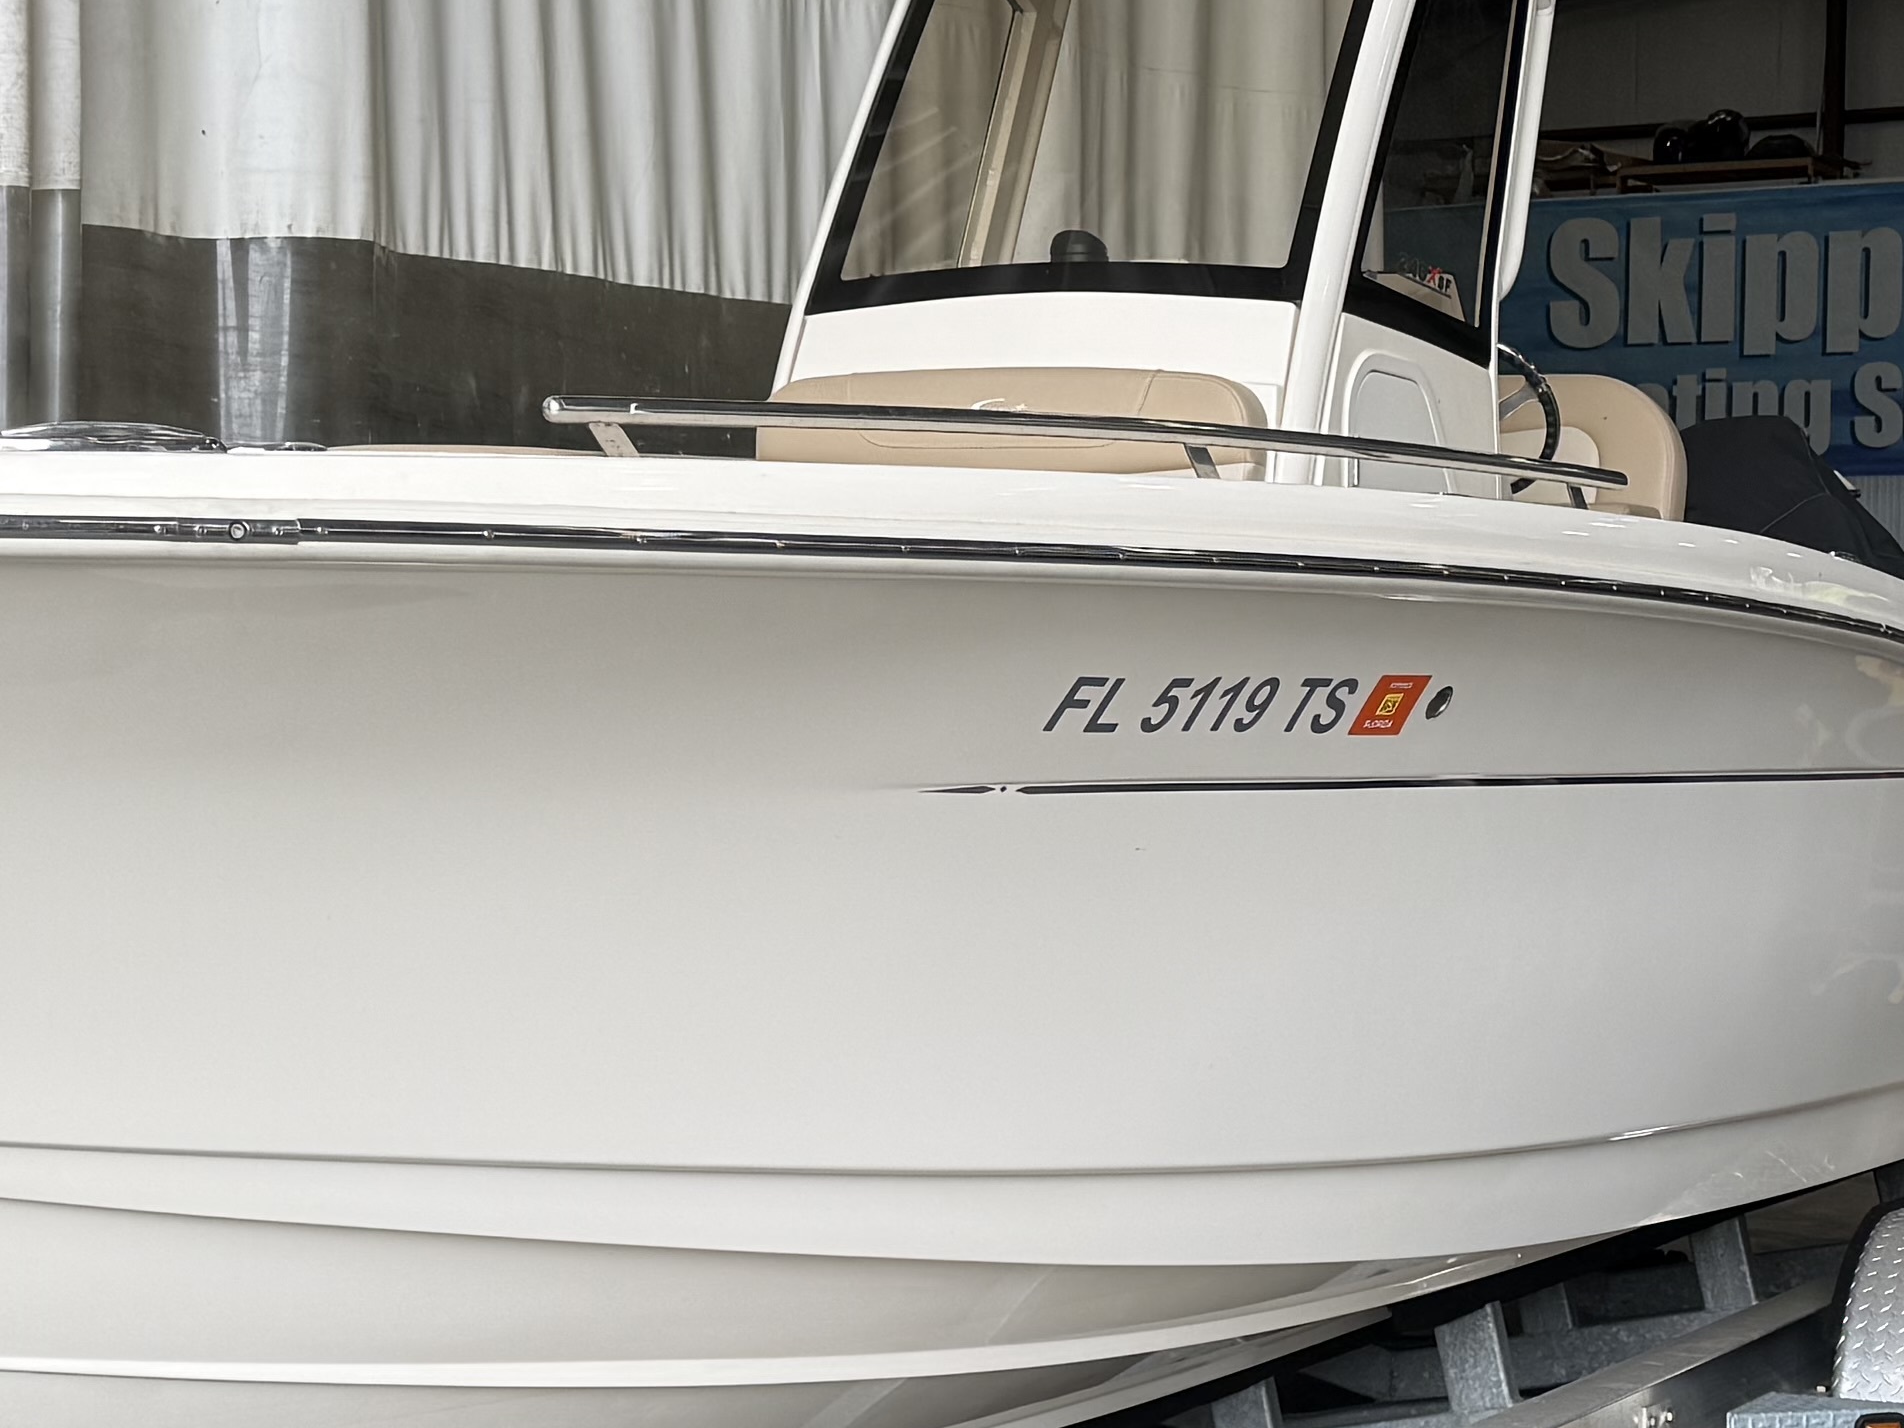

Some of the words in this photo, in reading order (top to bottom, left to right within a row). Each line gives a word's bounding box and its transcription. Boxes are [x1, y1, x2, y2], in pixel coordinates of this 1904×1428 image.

[1636, 367, 1833, 456] ting
[1042, 676, 1125, 733] FL
[1140, 676, 1281, 734] 5119
[1283, 678, 1358, 734] TS
